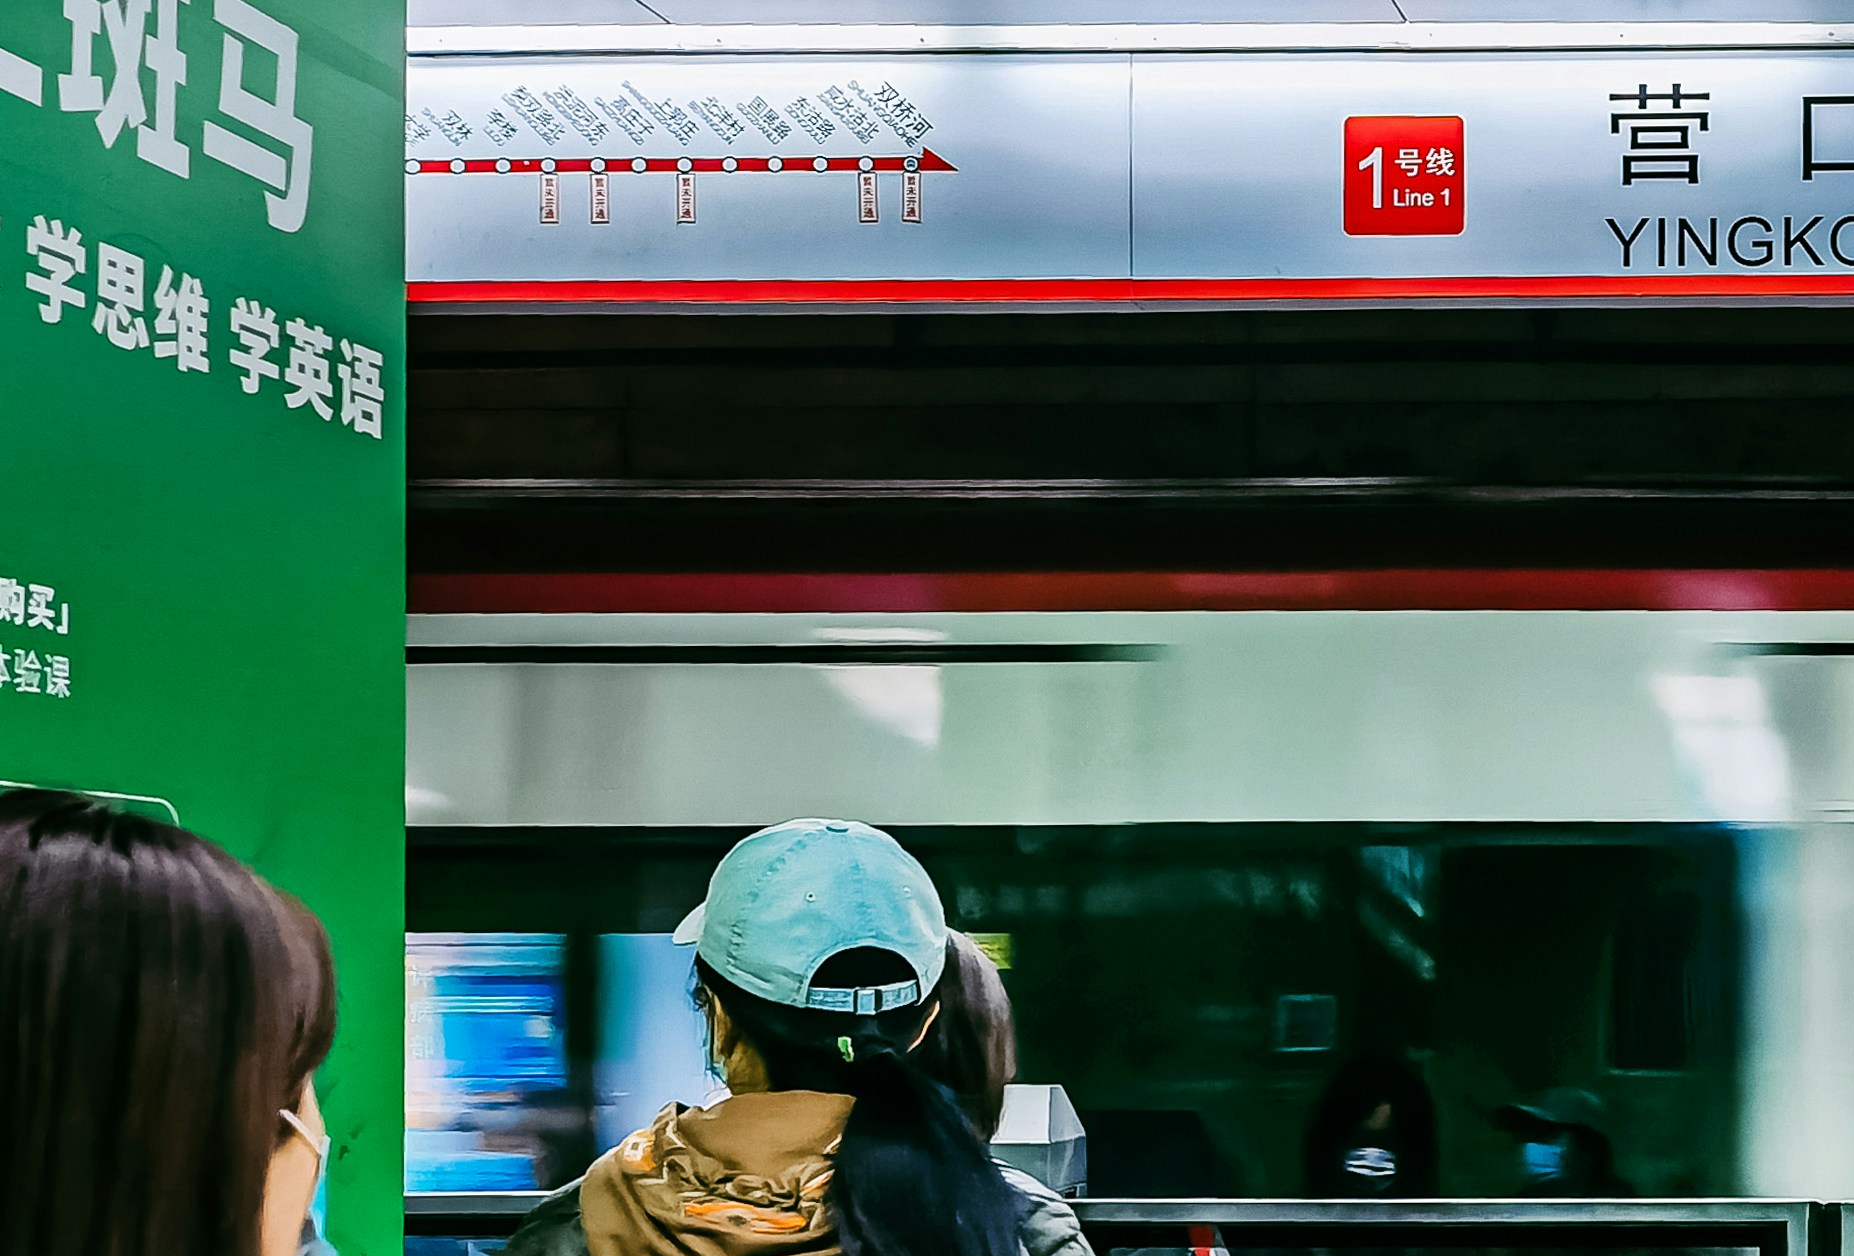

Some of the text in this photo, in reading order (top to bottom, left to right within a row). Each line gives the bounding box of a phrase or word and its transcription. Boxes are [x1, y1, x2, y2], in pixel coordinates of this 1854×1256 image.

[0, 0, 314, 233] 斑马
[874, 80, 934, 139] 双桥河
[1393, 188, 1450, 207] Line 1
[25, 214, 385, 440] 学思维 学英语
